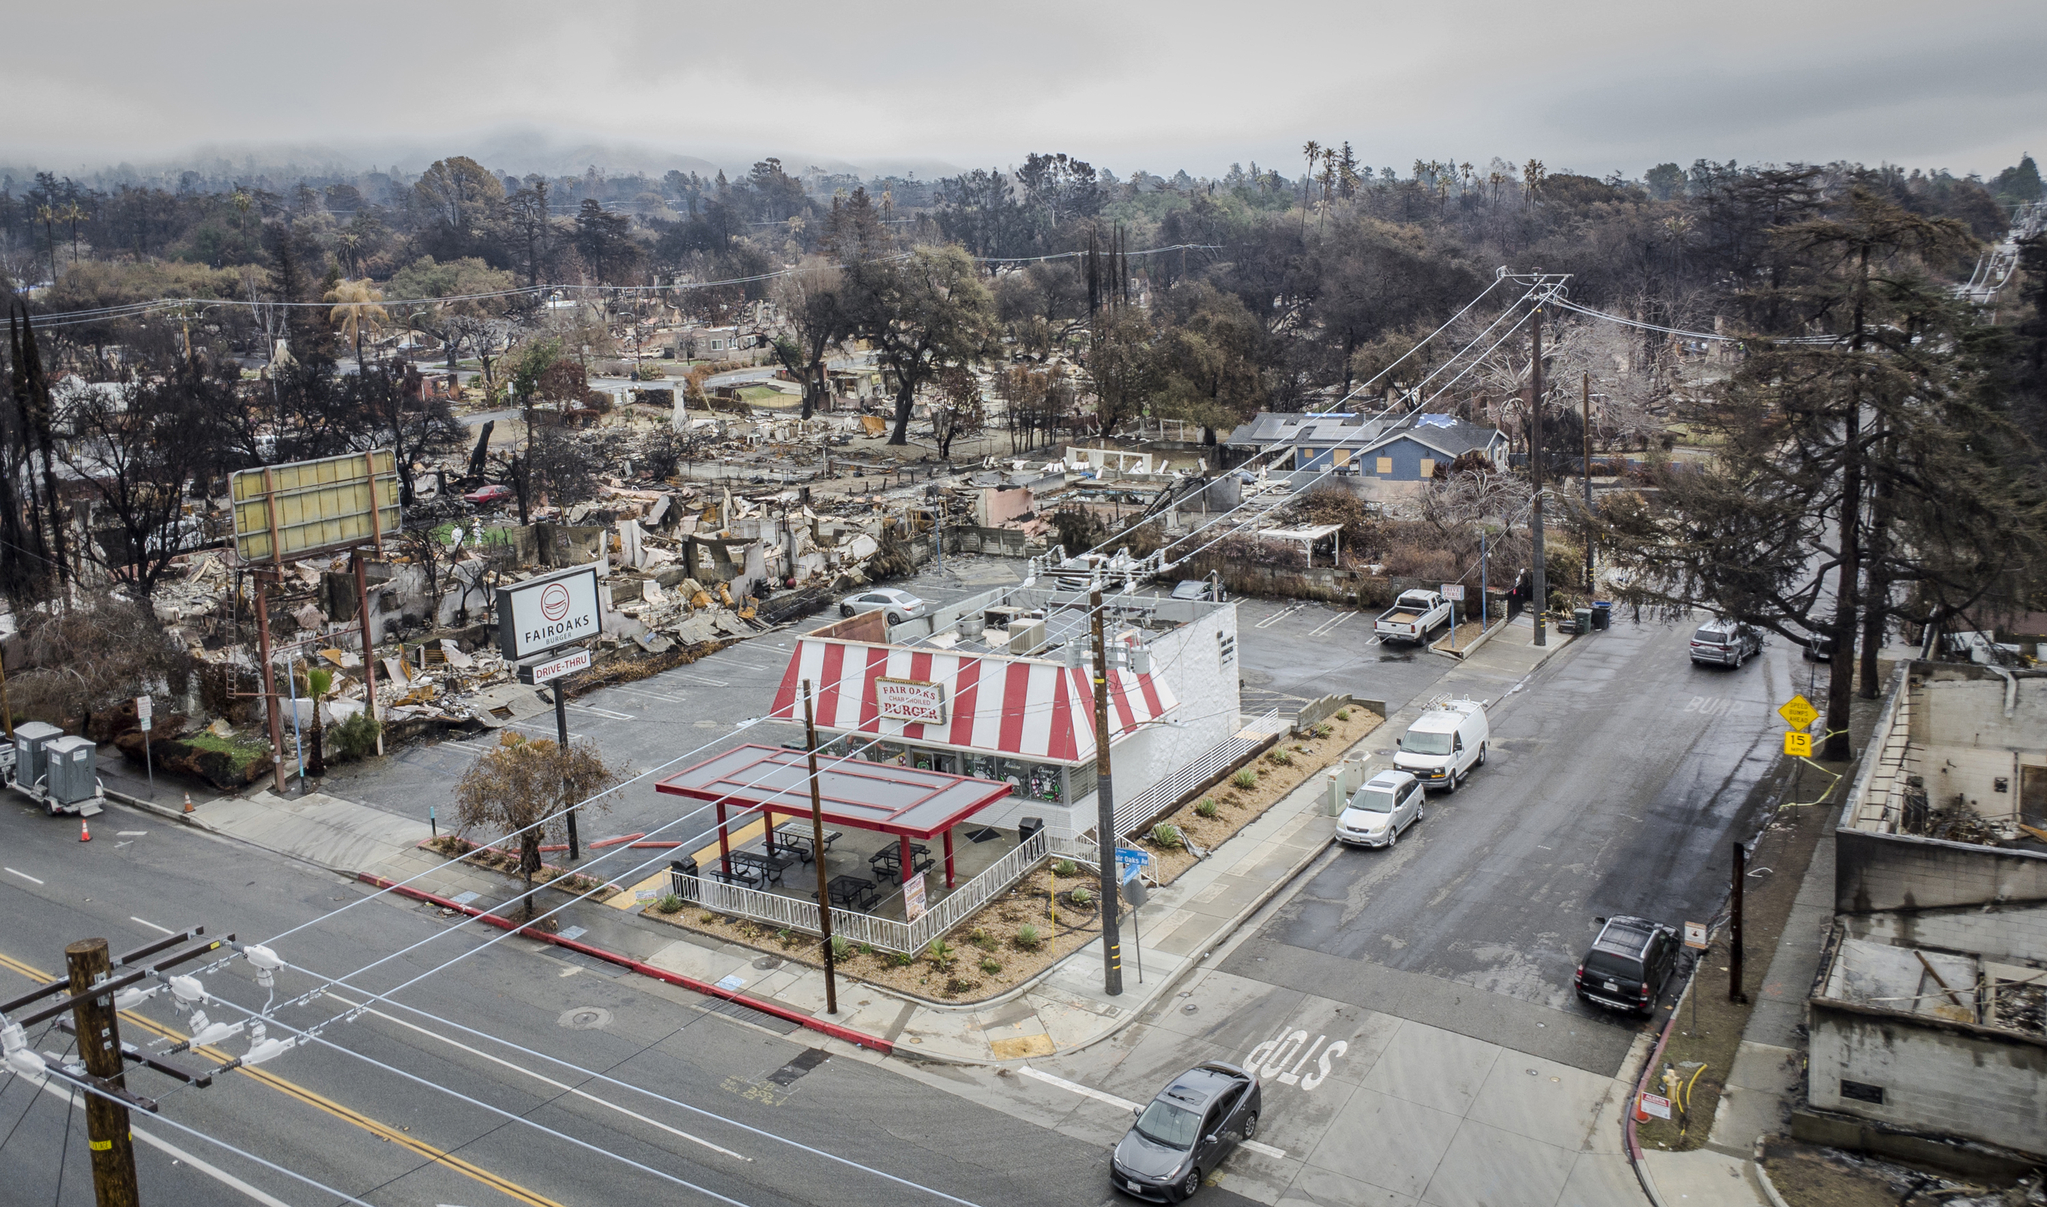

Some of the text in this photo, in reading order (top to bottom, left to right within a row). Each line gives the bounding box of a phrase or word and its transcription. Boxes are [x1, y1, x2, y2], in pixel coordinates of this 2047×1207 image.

[525, 614, 589, 643] FAIROAKS
[546, 632, 572, 645] BURGER
[536, 655, 587, 678] DRIVE-THRU
[883, 686, 936, 700] FAIR OAKS
[884, 702, 938, 719] BURGER
[1683, 696, 1745, 717] BUMP
[1790, 702, 1808, 710] SPEED
[1791, 735, 1806, 746] 15
[1243, 1026, 1348, 1091] STOP
